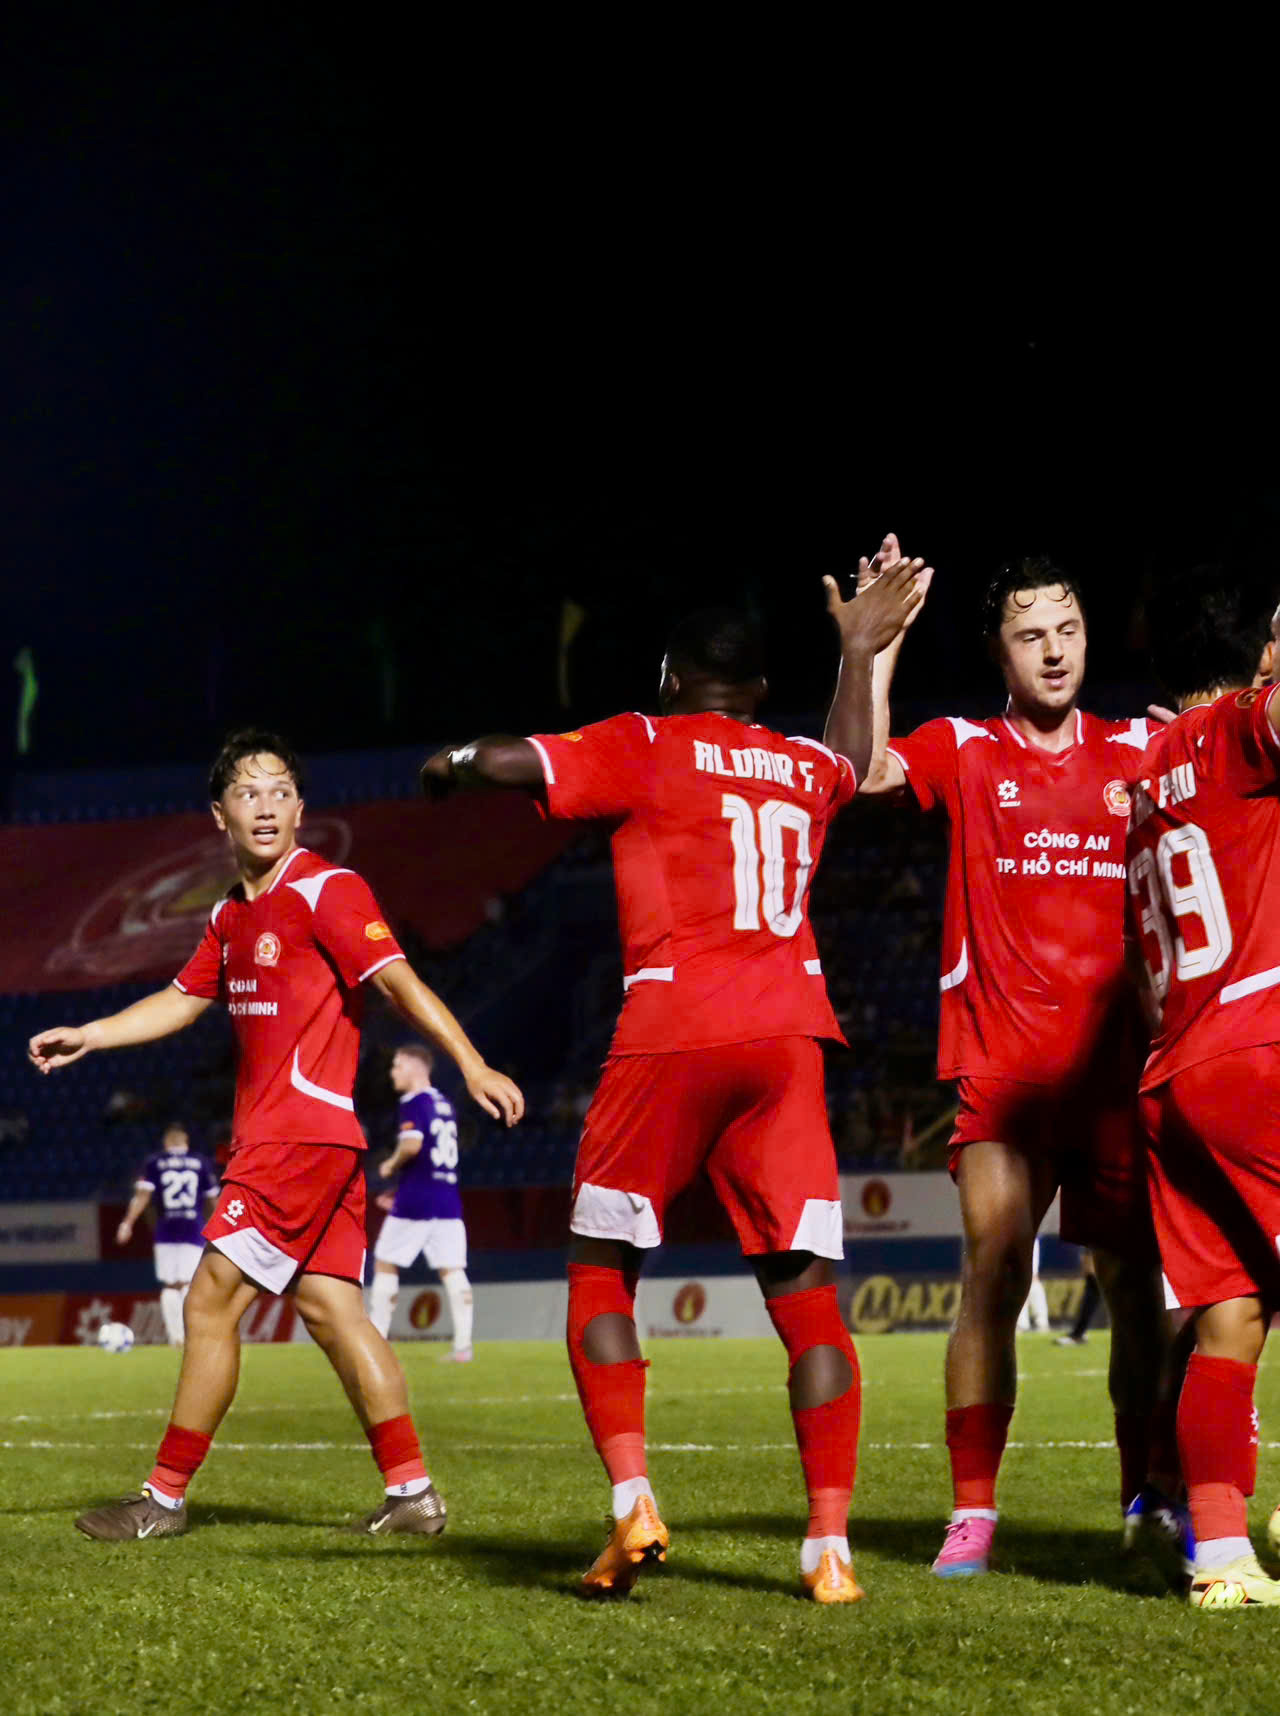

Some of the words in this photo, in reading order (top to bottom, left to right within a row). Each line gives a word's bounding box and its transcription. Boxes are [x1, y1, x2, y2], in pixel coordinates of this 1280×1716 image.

[693, 740, 795, 788] ALDAIR
[1024, 828, 1080, 849] CÔNG
[1083, 834, 1110, 851] AN
[721, 793, 813, 938] 10
[996, 858, 1017, 874] TP.
[1055, 857, 1090, 876] CHÍ
[1128, 822, 1233, 1003] 39
[248, 1002, 279, 1016] MINH
[161, 1169, 200, 1209] 23
